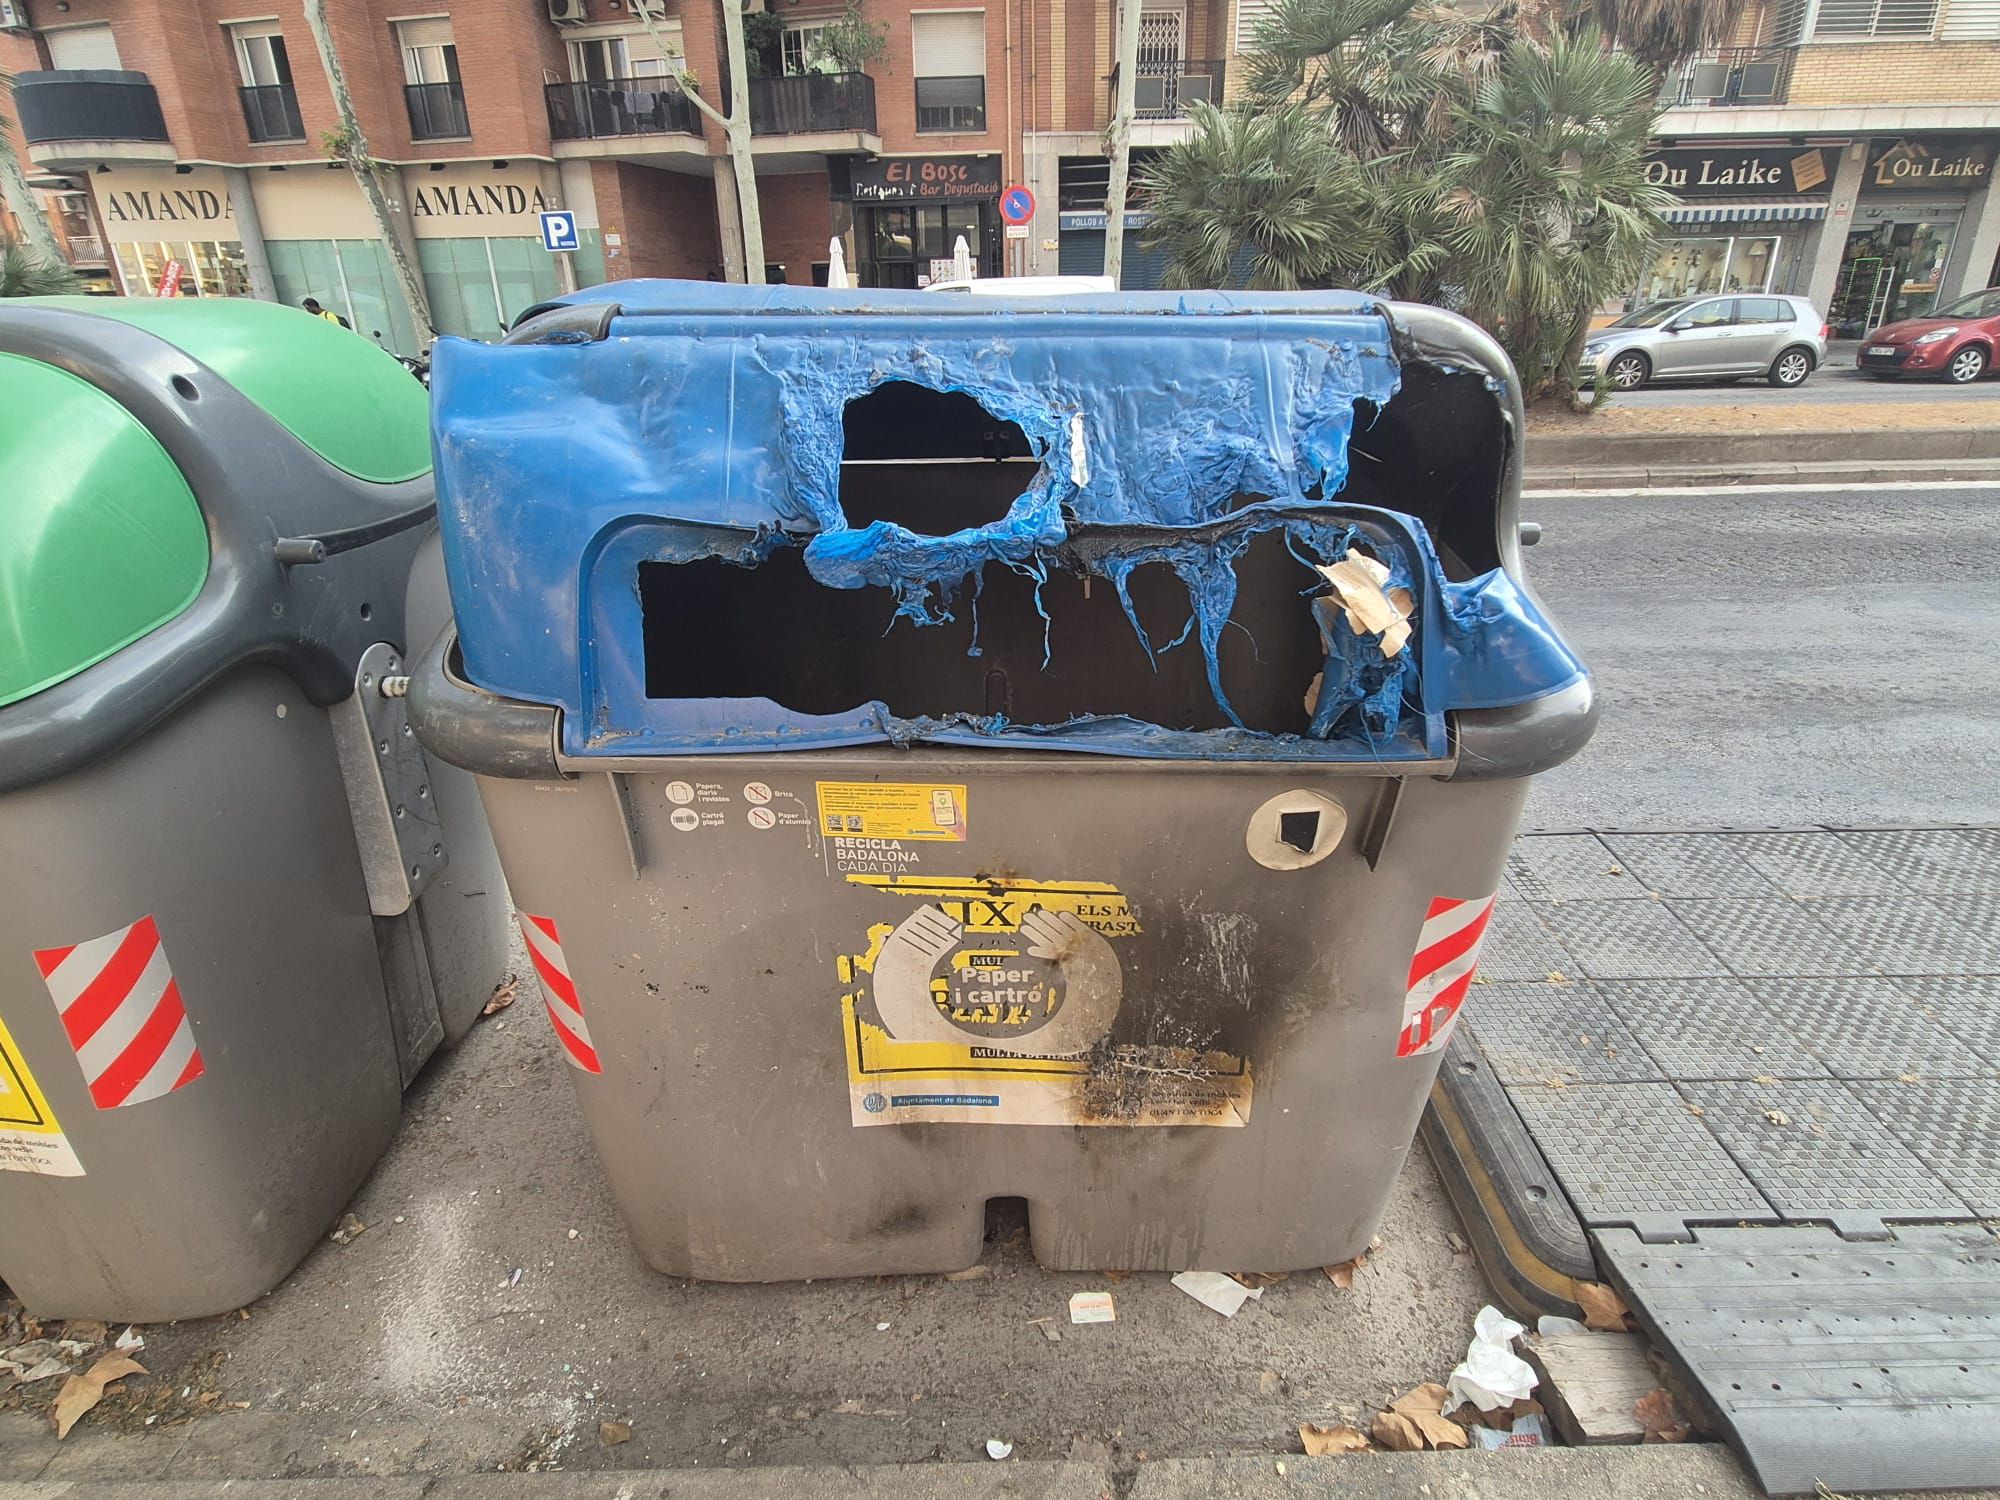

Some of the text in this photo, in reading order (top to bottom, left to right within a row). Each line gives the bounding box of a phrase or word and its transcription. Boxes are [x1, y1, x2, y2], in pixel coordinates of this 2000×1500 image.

[887, 162, 968, 182] El Bosc
[1697, 159, 1782, 185] Laike
[1893, 157, 1985, 177] Ou Laike
[920, 183, 941, 196] Bar
[943, 182, 999, 197] Degustació
[1071, 217, 1097, 227] POLLOS
[545, 216, 569, 247] P
[778, 812, 799, 820] Paper
[835, 838, 902, 850] RECICLA
[836, 849, 920, 863] BADALONA
[837, 861, 879, 873] CADA
[1077, 904, 1111, 916] ELS
[962, 967, 1034, 986] Paper
[955, 988, 962, 1004] i
[968, 985, 1042, 1003] cartró
[898, 1096, 993, 1105] Ajuntament de Badalona
